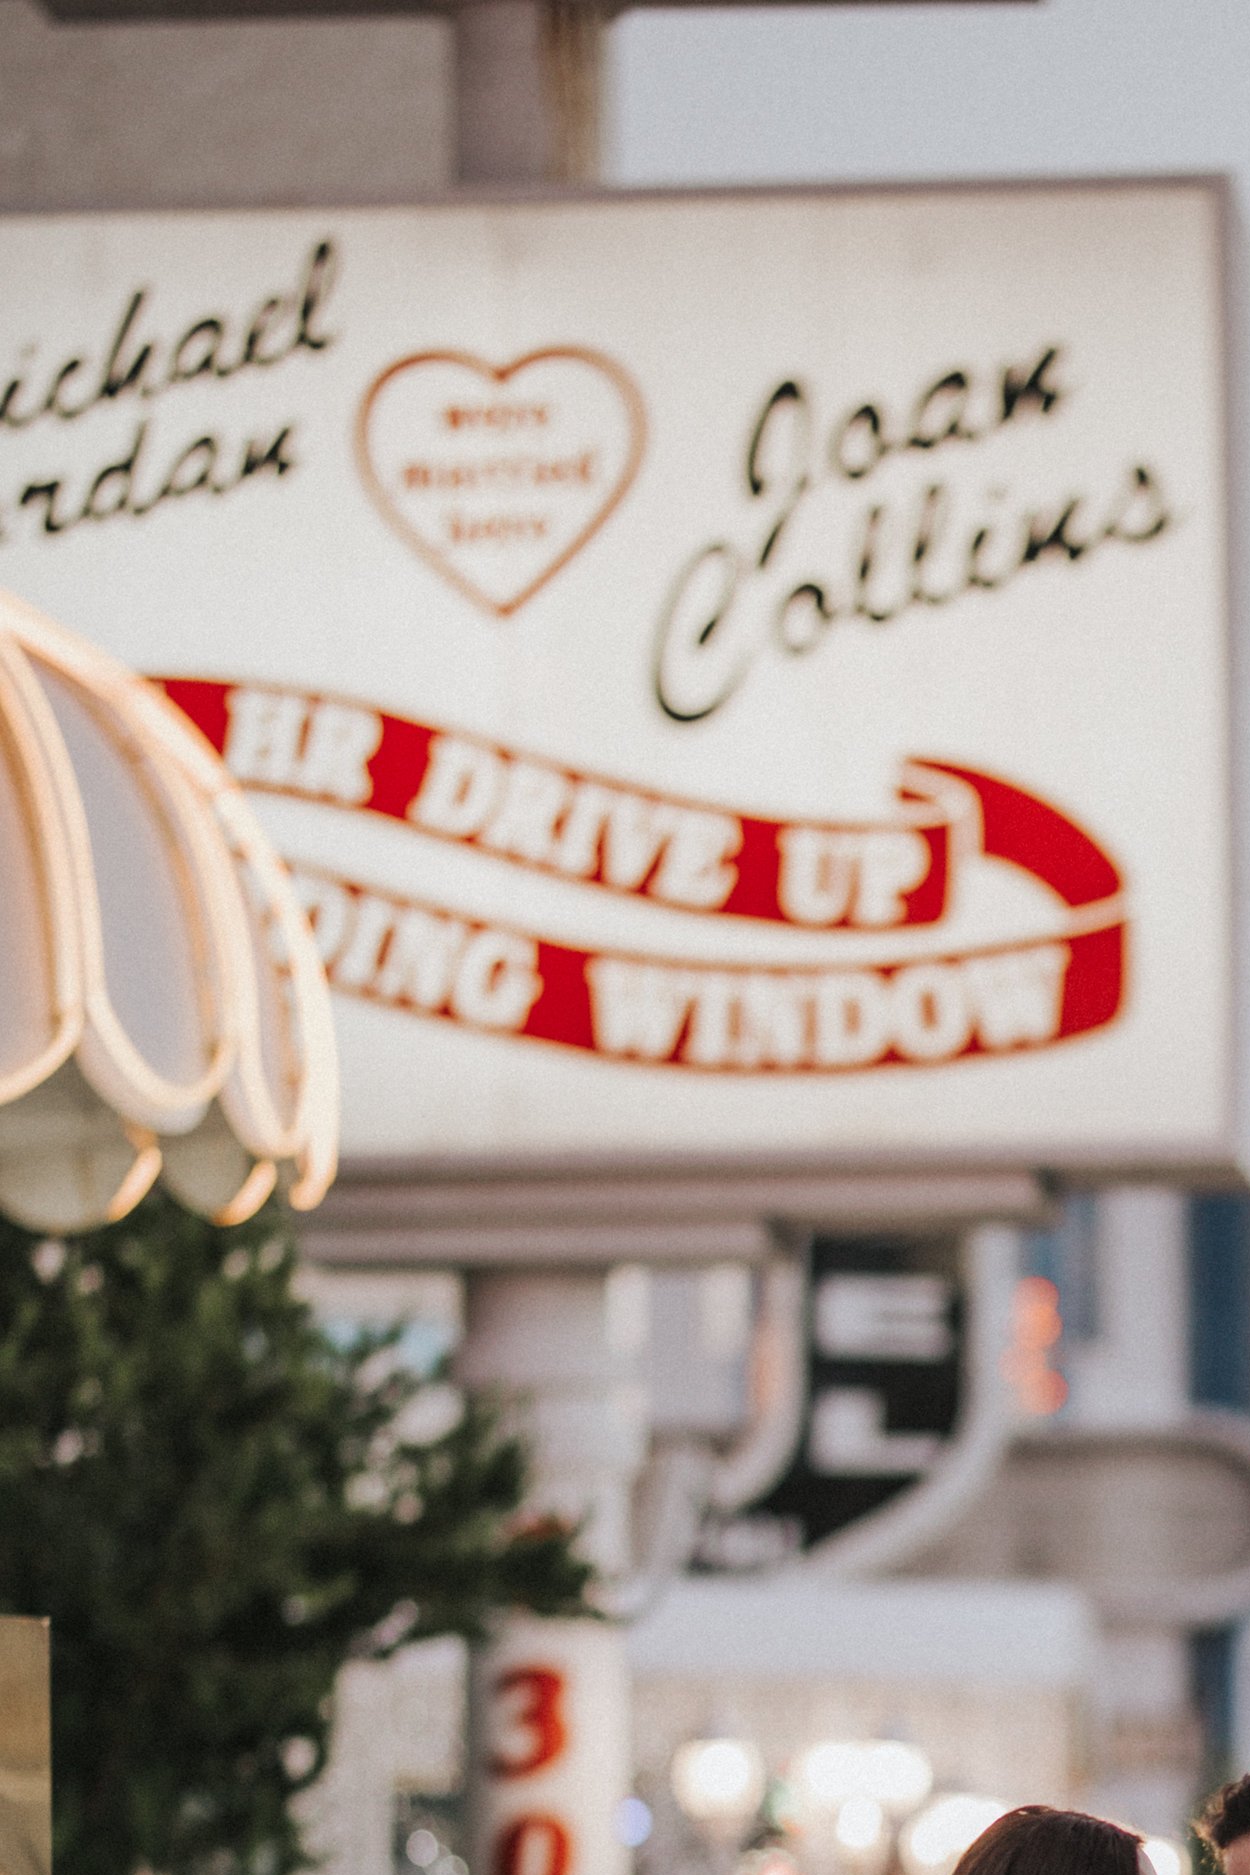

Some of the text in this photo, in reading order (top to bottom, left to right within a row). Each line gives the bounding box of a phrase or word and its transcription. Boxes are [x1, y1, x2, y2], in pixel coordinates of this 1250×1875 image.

[0, 420, 294, 536] rdan
[744, 345, 1062, 568] Joan
[650, 462, 1172, 724] Collins
[225, 688, 932, 927] HR DRIVE UP
[583, 942, 1073, 1066] WINDOW
